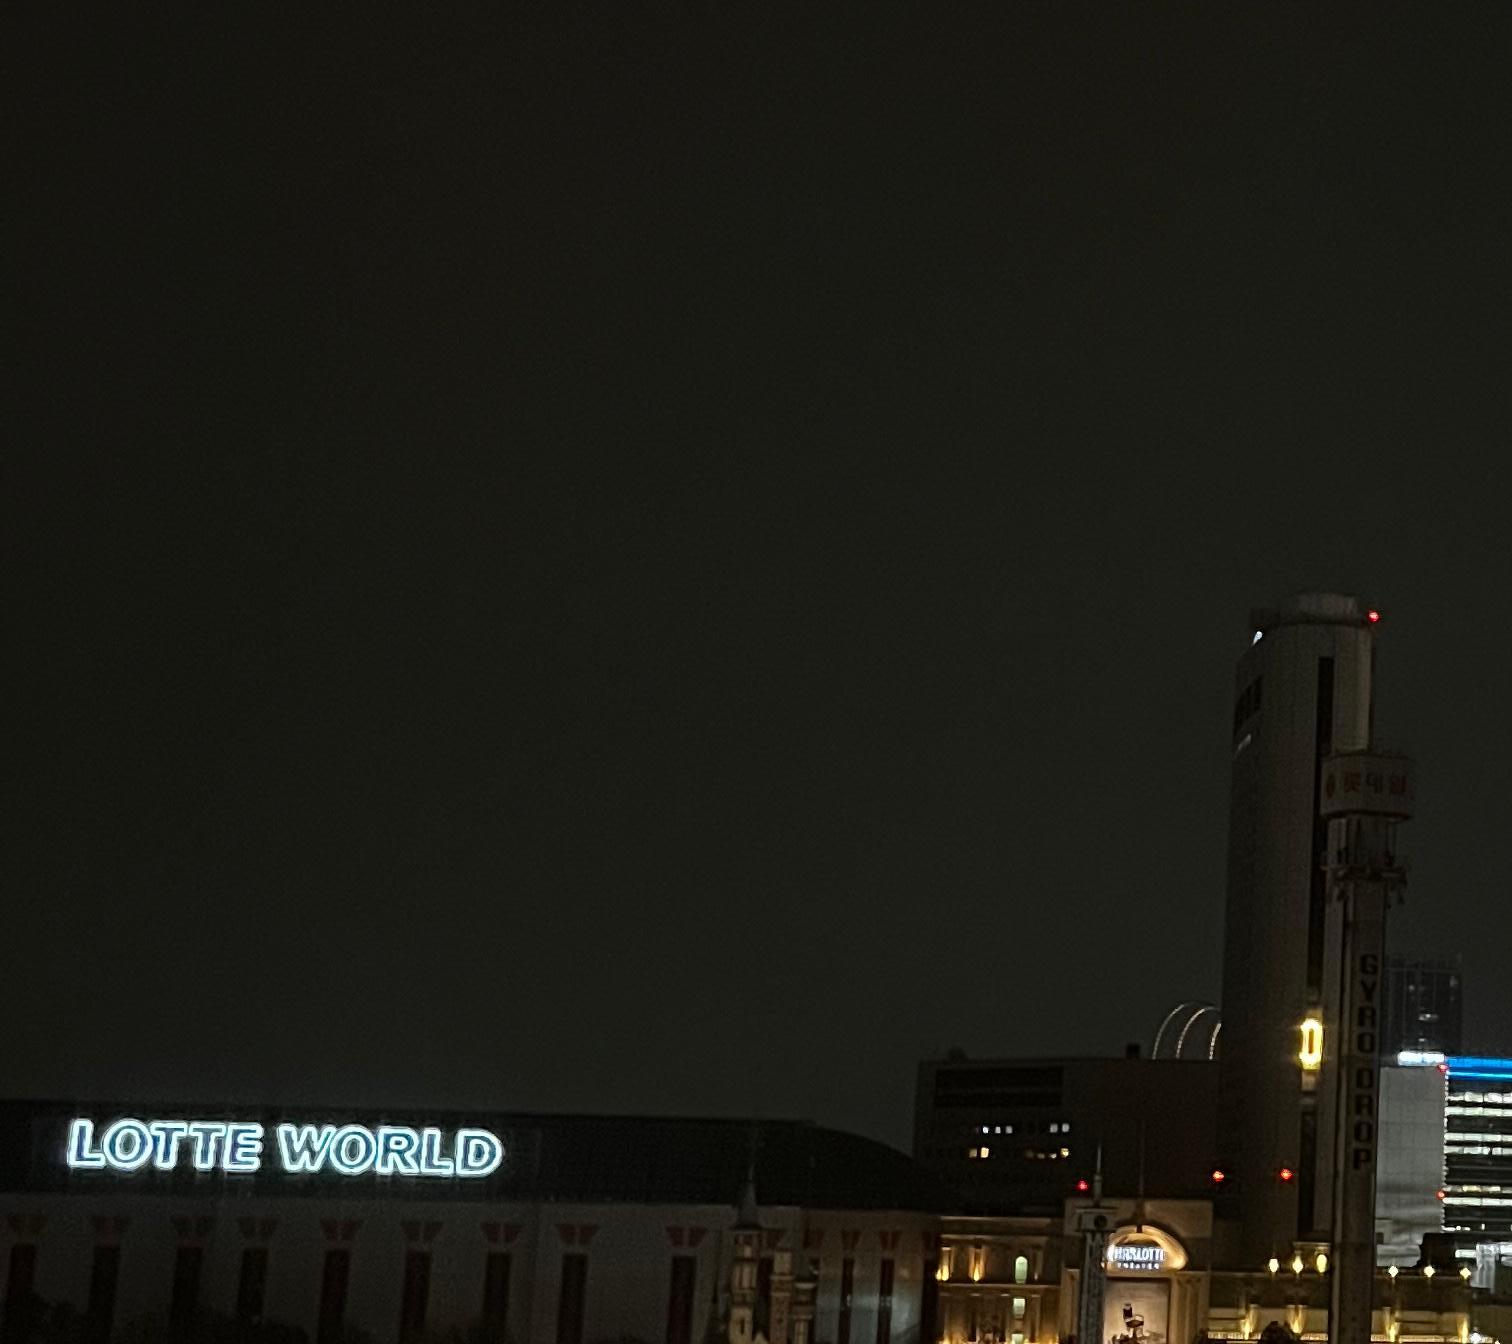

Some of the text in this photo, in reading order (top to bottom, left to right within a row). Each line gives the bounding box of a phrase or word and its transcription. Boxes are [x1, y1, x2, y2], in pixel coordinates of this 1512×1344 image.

[1354, 954, 1378, 1170] GYRO DROP
[67, 1118, 505, 1177] LOTTE WORLD
